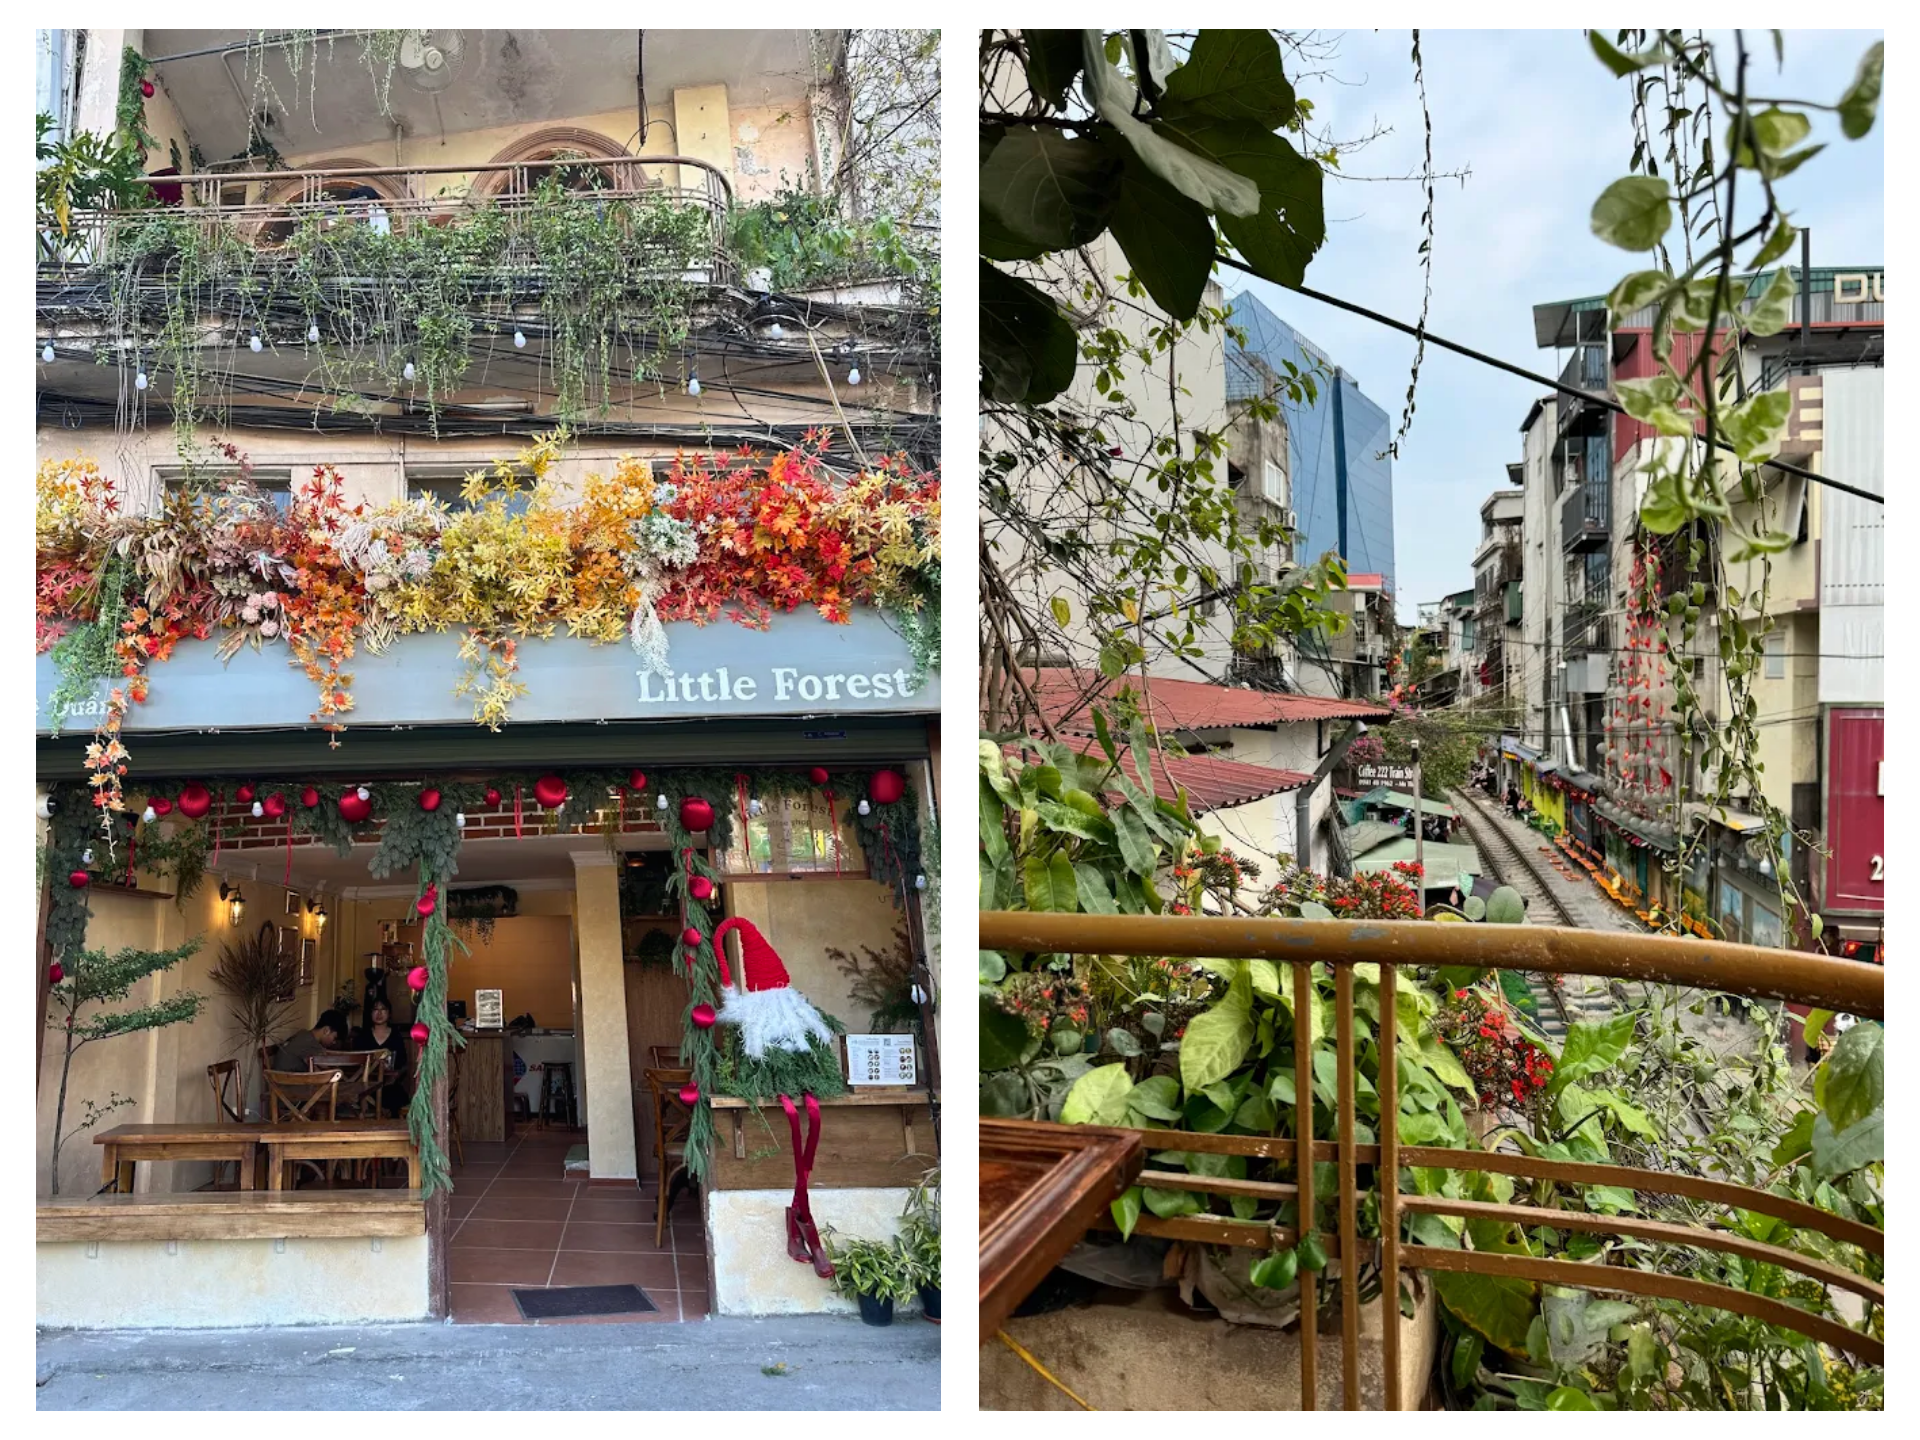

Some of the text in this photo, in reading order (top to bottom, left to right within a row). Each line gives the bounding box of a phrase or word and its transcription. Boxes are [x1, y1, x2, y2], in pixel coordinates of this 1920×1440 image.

[636, 667, 915, 702] Little Forest
[1358, 764, 1420, 780] Coffee 222 Train Str
